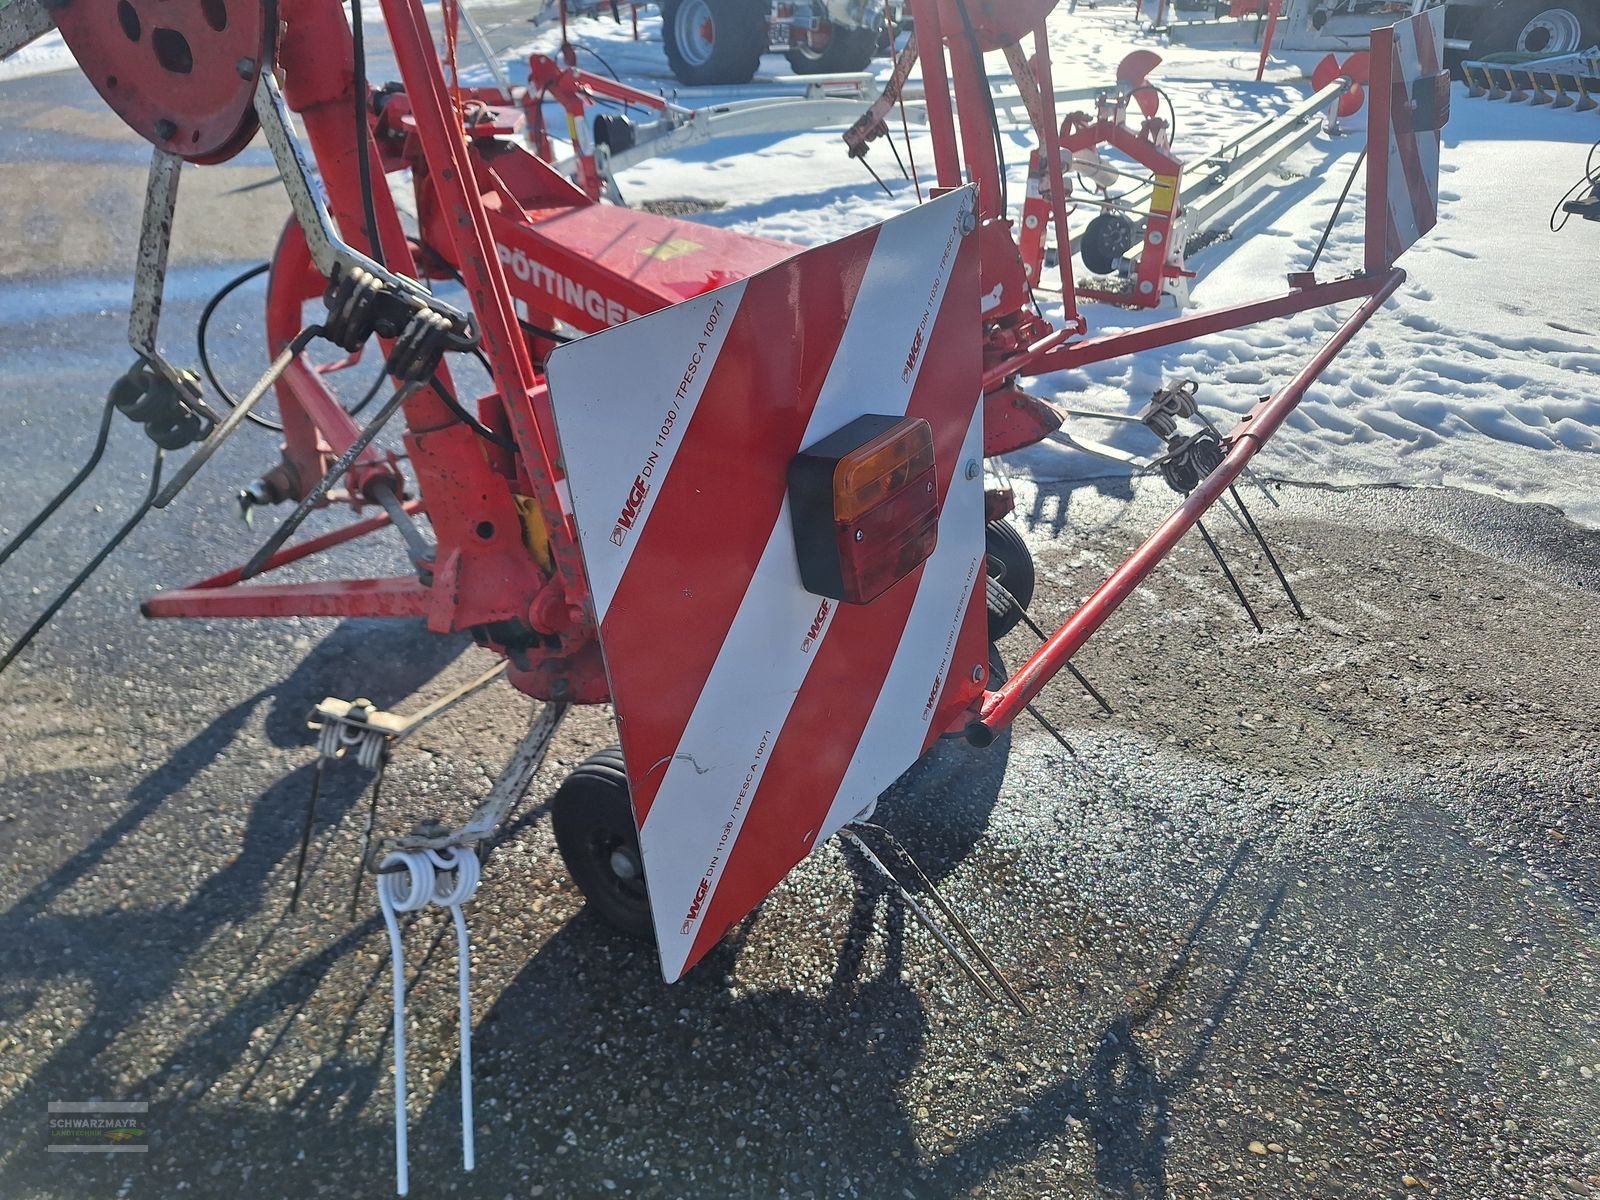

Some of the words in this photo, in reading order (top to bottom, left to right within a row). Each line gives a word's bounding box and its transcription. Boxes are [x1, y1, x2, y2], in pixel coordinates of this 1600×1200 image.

[906, 328, 922, 370] WGF
[920, 311, 930, 330] DIN
[928, 280, 940, 307] 11030
[939, 234, 954, 271] TPESC
[618, 475, 647, 530] WGF
[642, 451, 659, 478] DIN
[655, 407, 677, 448] 11030
[675, 352, 702, 400] TPESC
[698, 341, 707, 353] A
[703, 299, 724, 338] 10071
[807, 598, 832, 641] WGF
[926, 675, 942, 710] WGF
[938, 659, 947, 675] DIN
[944, 630, 955, 655] 11030
[966, 557, 977, 582] 10071
[687, 877, 710, 919] WGF
[706, 856, 719, 877] DIN
[717, 821, 733, 852] 11030
[734, 775, 752, 812] TPESC
[750, 763, 758, 772] A
[755, 730, 771, 760] 10071
